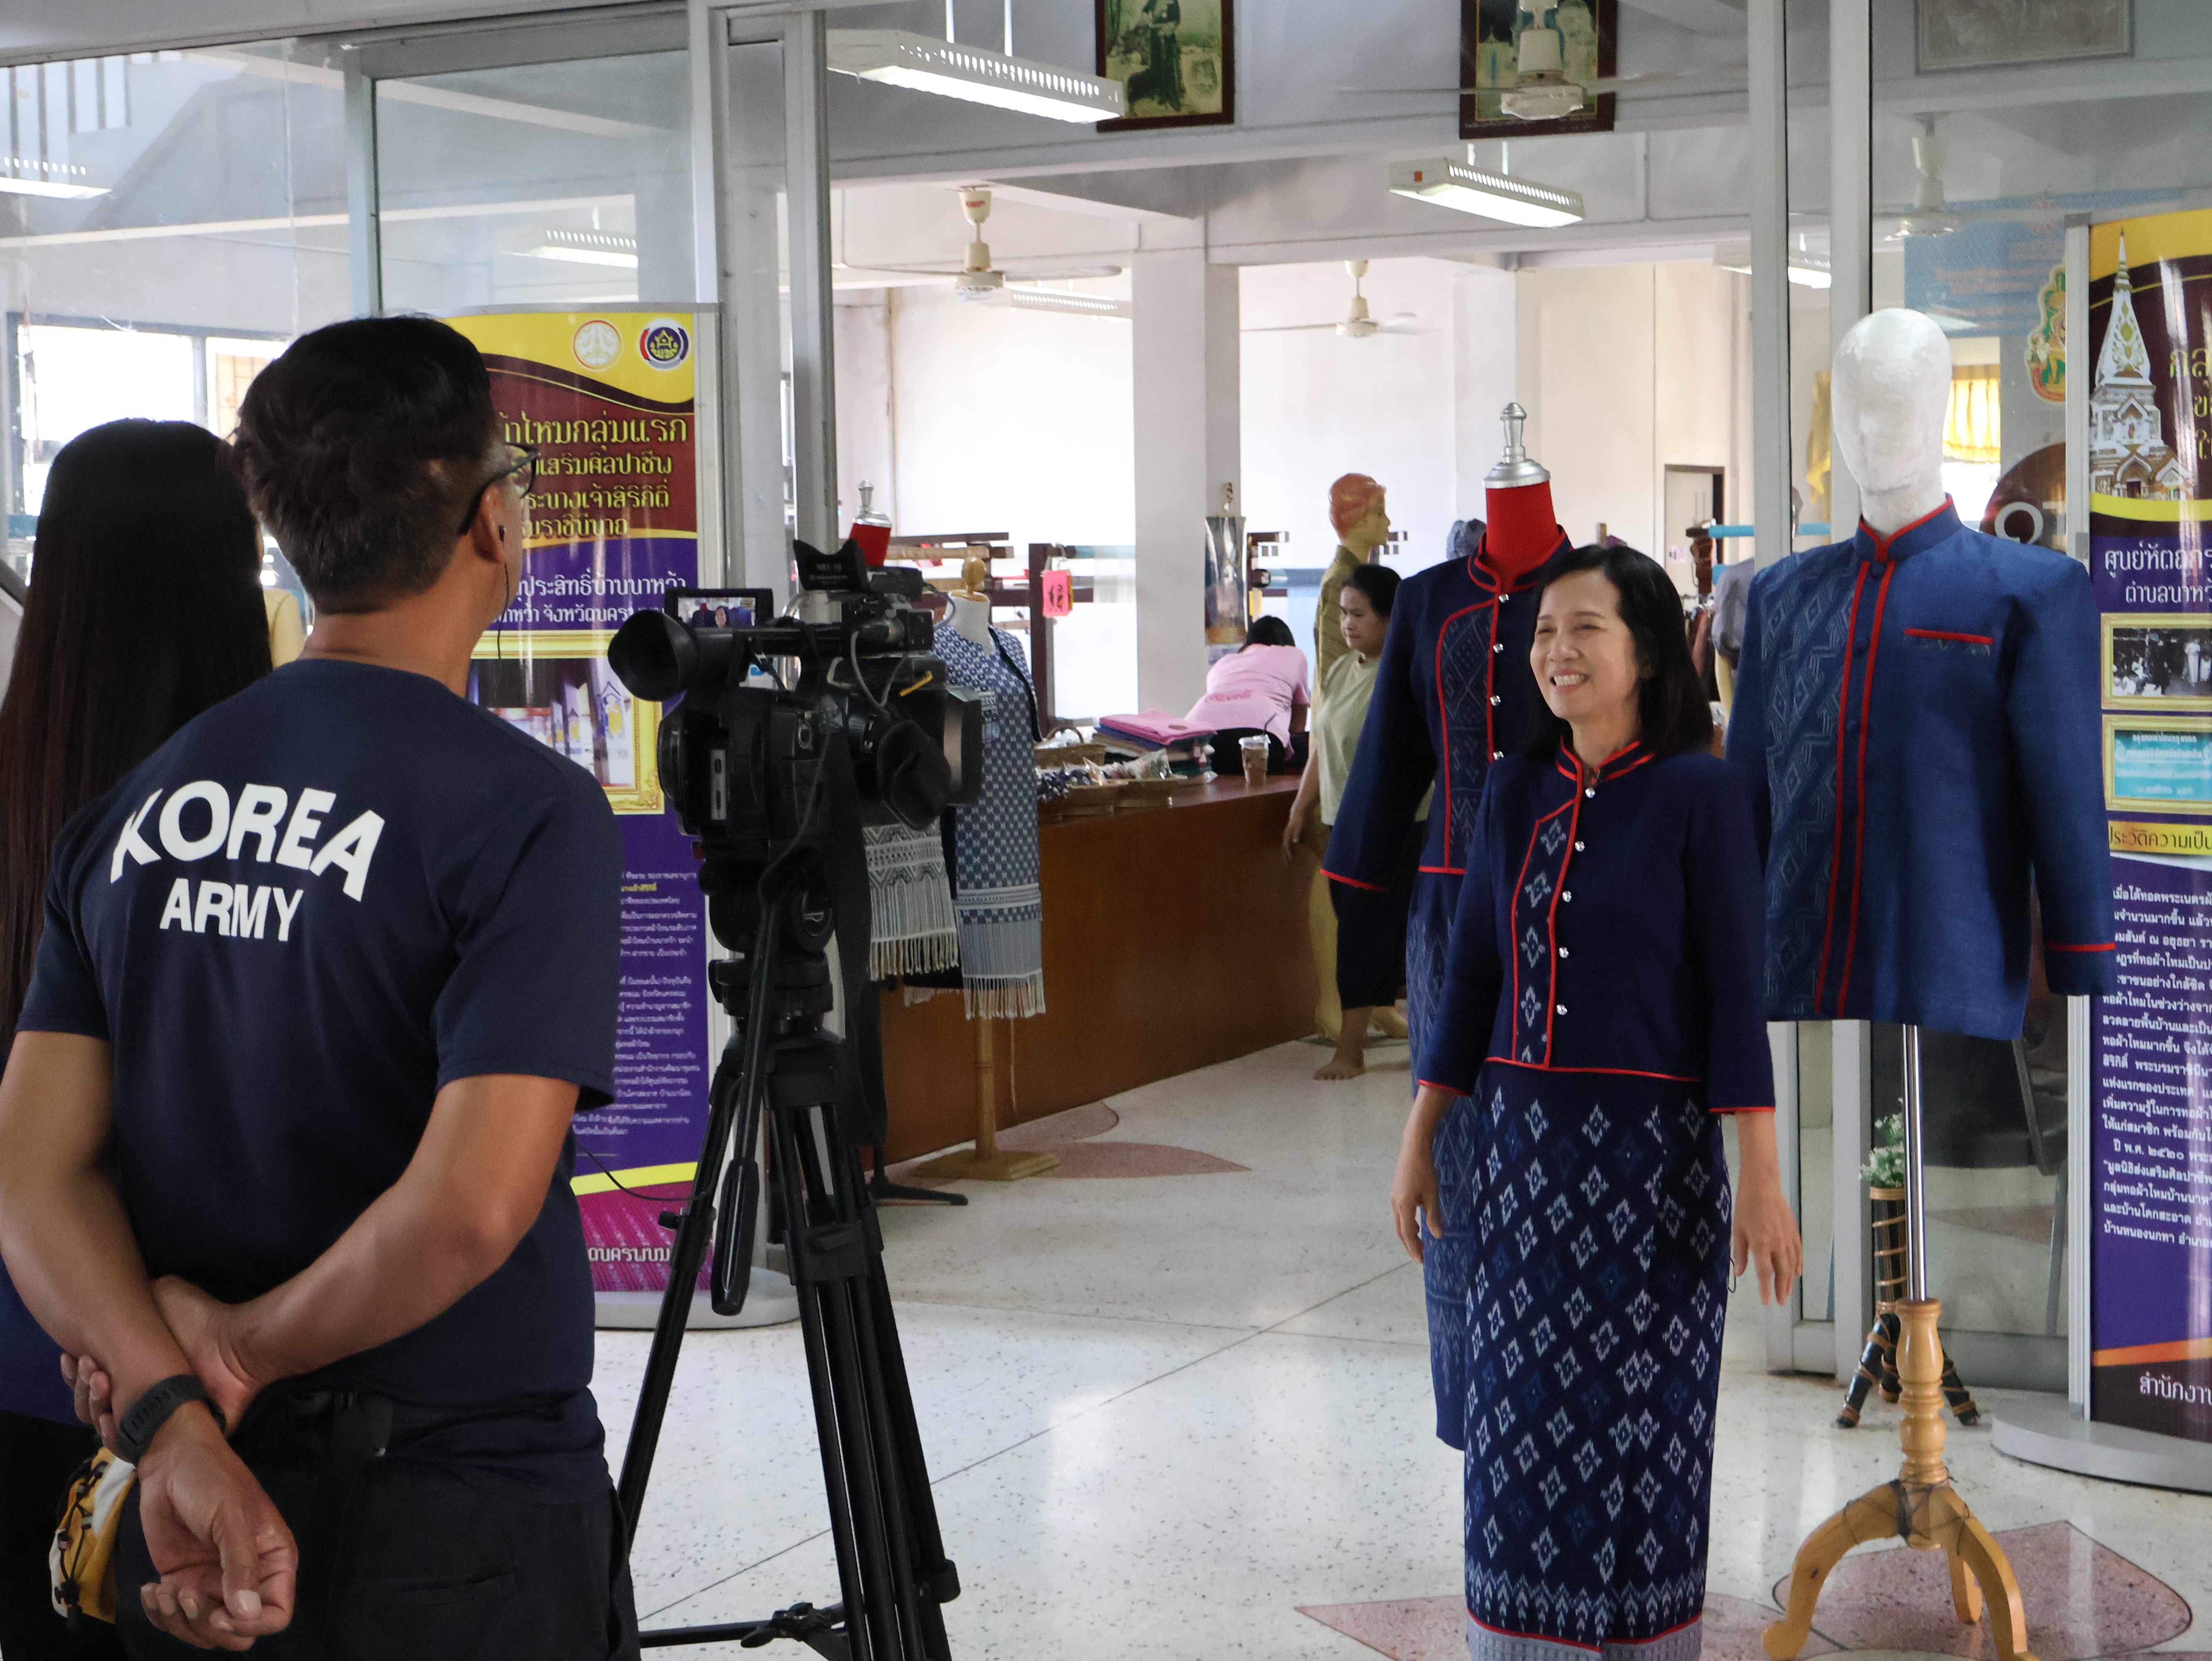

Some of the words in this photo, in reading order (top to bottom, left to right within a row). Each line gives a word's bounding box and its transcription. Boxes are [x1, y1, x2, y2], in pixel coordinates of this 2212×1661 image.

[499, 410, 688, 451] ้าไหมกลุ่มแรก
[521, 479, 670, 510] ระนางเจ้าสิริกิติ์
[110, 780, 385, 902] KOREA
[159, 877, 303, 941] ARMY
[2188, 912, 2212, 927] แล้ว
[2149, 935, 2159, 945] ณ
[2163, 936, 2196, 950] อยุธยา
[2117, 973, 2205, 992] ชาชนอย่างใกล้ชิด
[2102, 1033, 2180, 1053] ทอผ้าไหมมากขึ้น
[2135, 1060, 2212, 1078] พระบรมราชินีน
[2102, 1075, 2194, 1097] แห่งแรกของประเทศ
[2102, 1113, 2160, 1136] ให้แก่สมาชิก
[2113, 1137, 2121, 1152] ปี
[2124, 1143, 2144, 1155] พ.ศ.
[2103, 1201, 2192, 1225] และบ้านโคกสะอาด
[2178, 1231, 2212, 1249] อำเภอ
